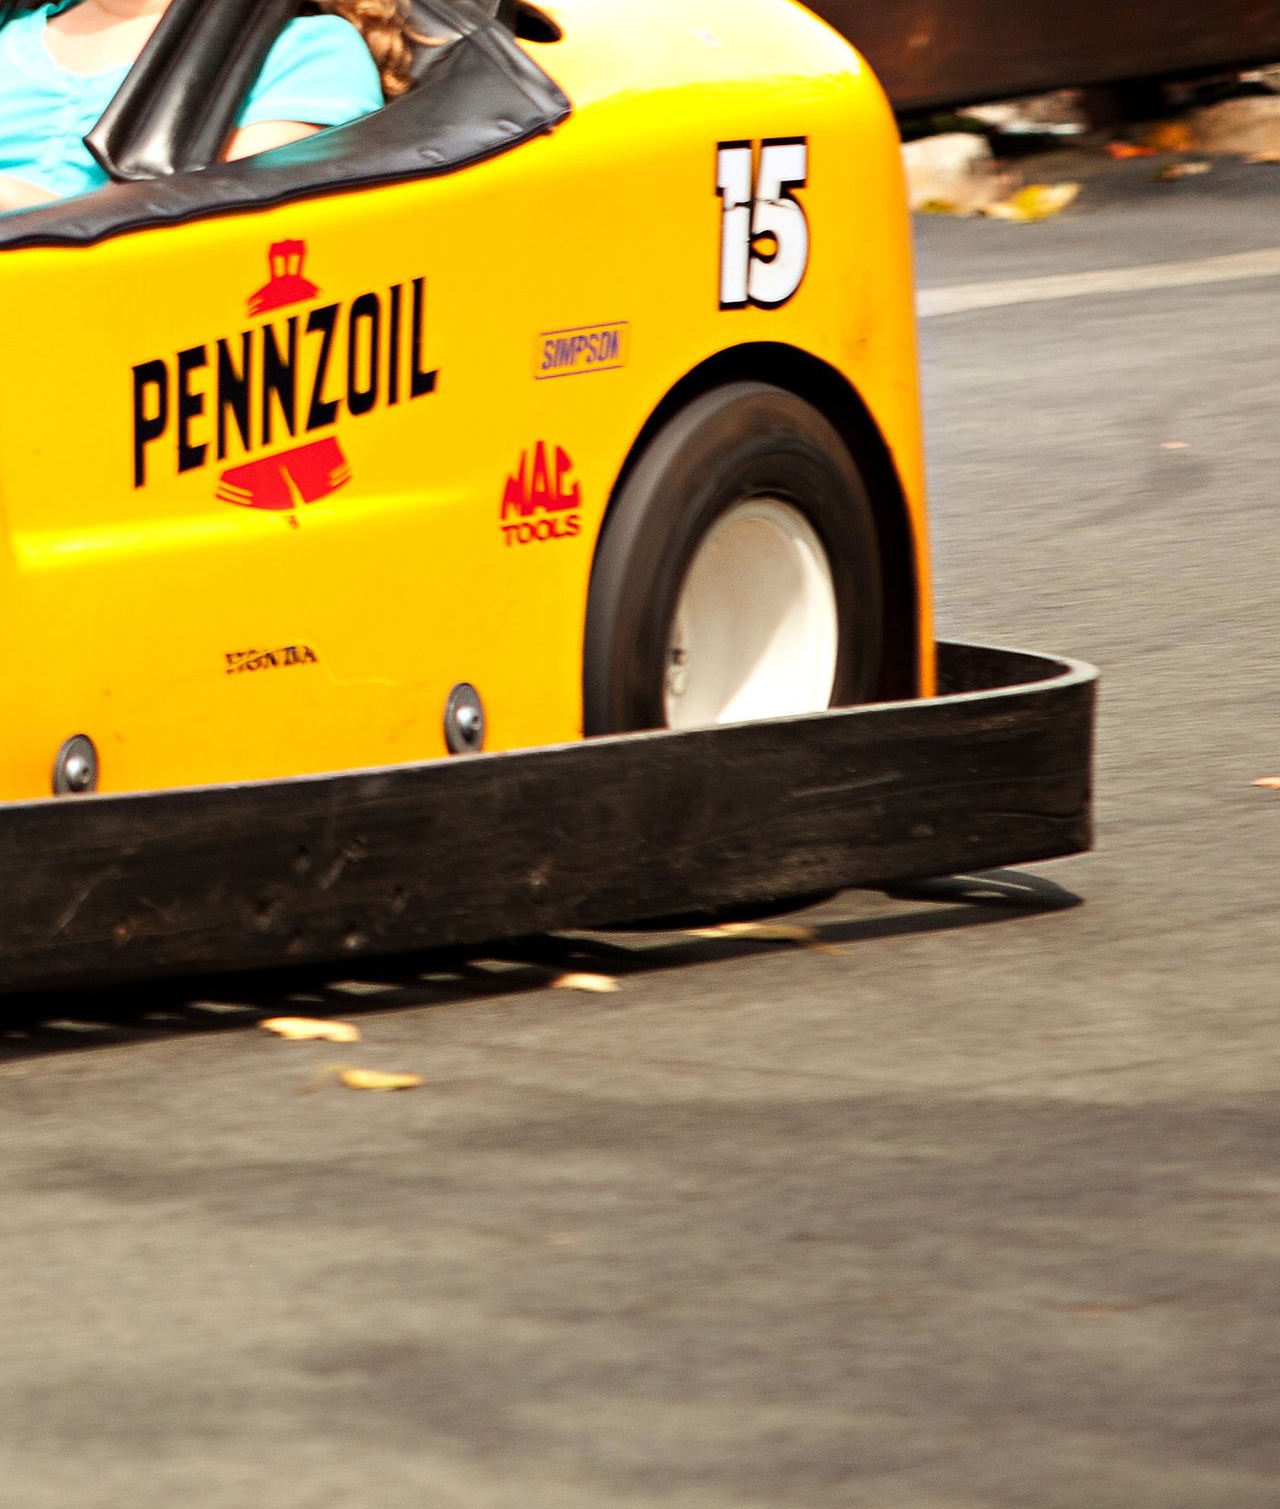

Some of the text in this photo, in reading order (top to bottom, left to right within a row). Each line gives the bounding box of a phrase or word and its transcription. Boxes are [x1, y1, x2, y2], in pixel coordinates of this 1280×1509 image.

[715, 136, 810, 311] 15
[131, 276, 440, 490] PENNZOIL
[541, 330, 619, 370] SIMPSON
[500, 440, 581, 519] MAC
[501, 515, 581, 547] TOOLS
